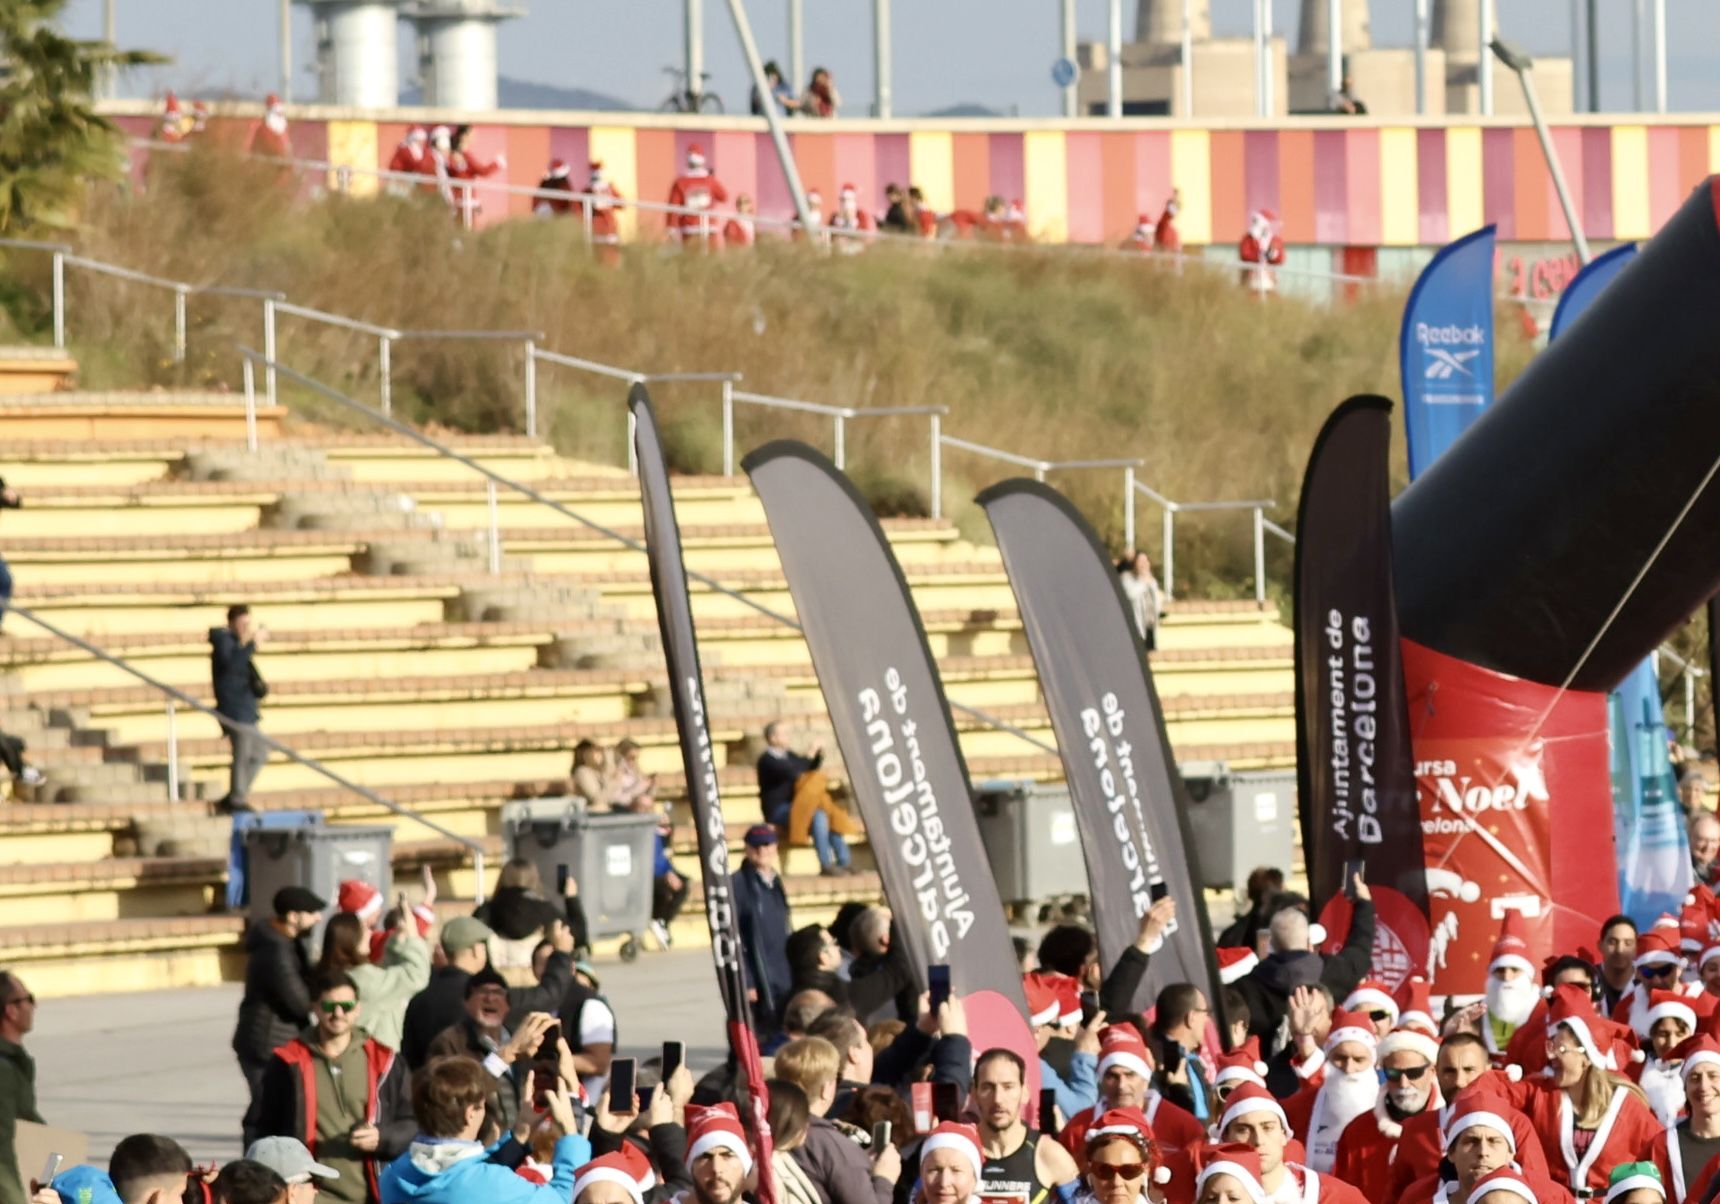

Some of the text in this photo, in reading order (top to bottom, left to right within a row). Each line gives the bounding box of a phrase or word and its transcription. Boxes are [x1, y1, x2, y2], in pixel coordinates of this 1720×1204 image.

[1416, 322, 1485, 346] Reebok
[1325, 608, 1344, 650] de
[1351, 615, 1384, 844] Barcelona
[1431, 776, 1529, 813] Noel
